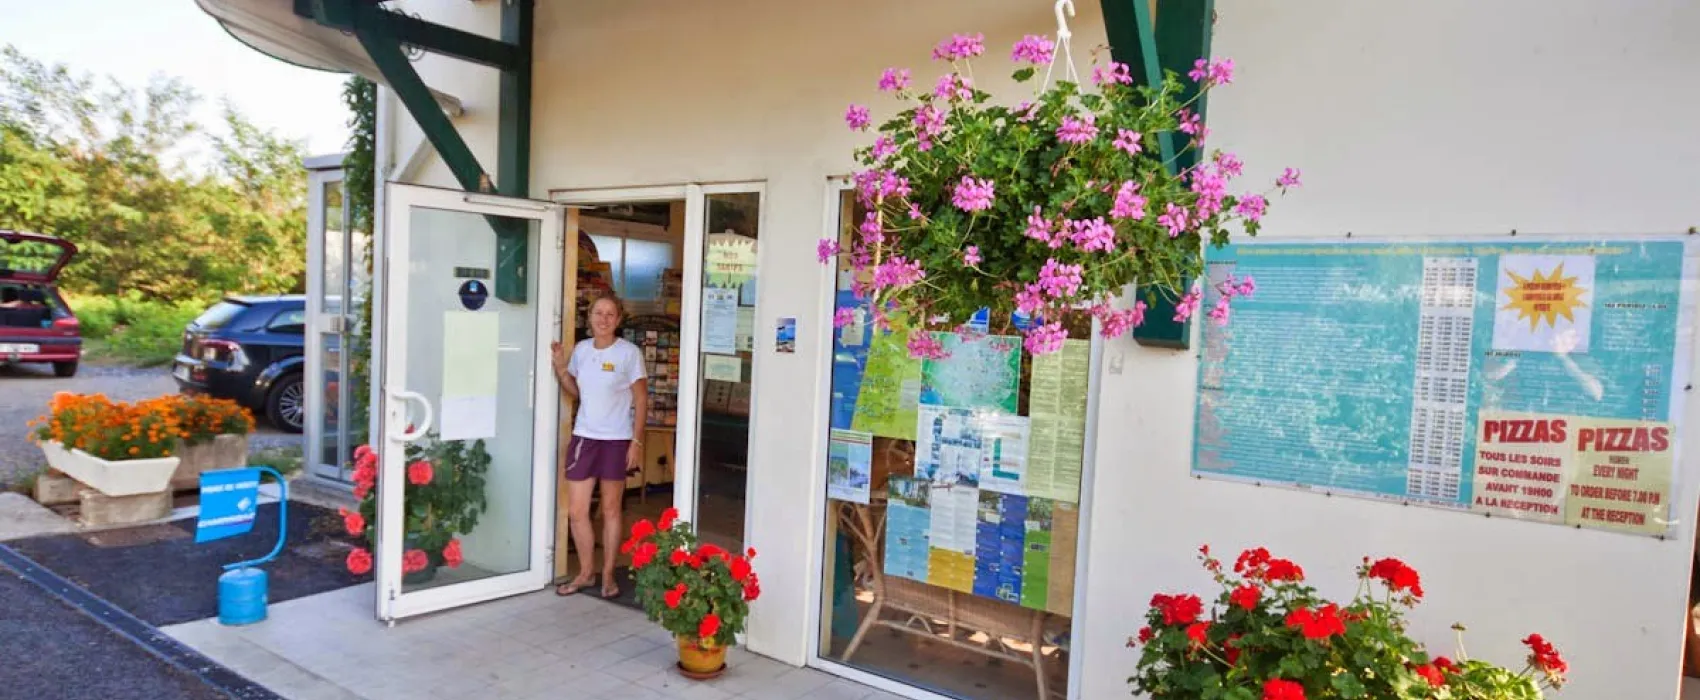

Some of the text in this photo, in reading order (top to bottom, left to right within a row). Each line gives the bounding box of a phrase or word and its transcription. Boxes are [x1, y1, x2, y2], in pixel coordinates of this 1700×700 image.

[1483, 420, 1566, 443] PIZZAS
[1578, 426, 1669, 452] PIZZAS
[1479, 450, 1561, 467] TOUS LES SOIRS
[1478, 465, 1560, 483] SUR COMMANDE
[1593, 464, 1639, 480] EVERY NIGHT
[1485, 482, 1553, 498] AVANT 19H00
[1570, 483, 1579, 496] TO
[1581, 485, 1603, 499] ORDER
[1604, 487, 1632, 502] BEFORE
[1485, 497, 1497, 507] LA
[1500, 498, 1558, 515] RECEPTION
[1581, 506, 1645, 525] AT THE RECEPTION
